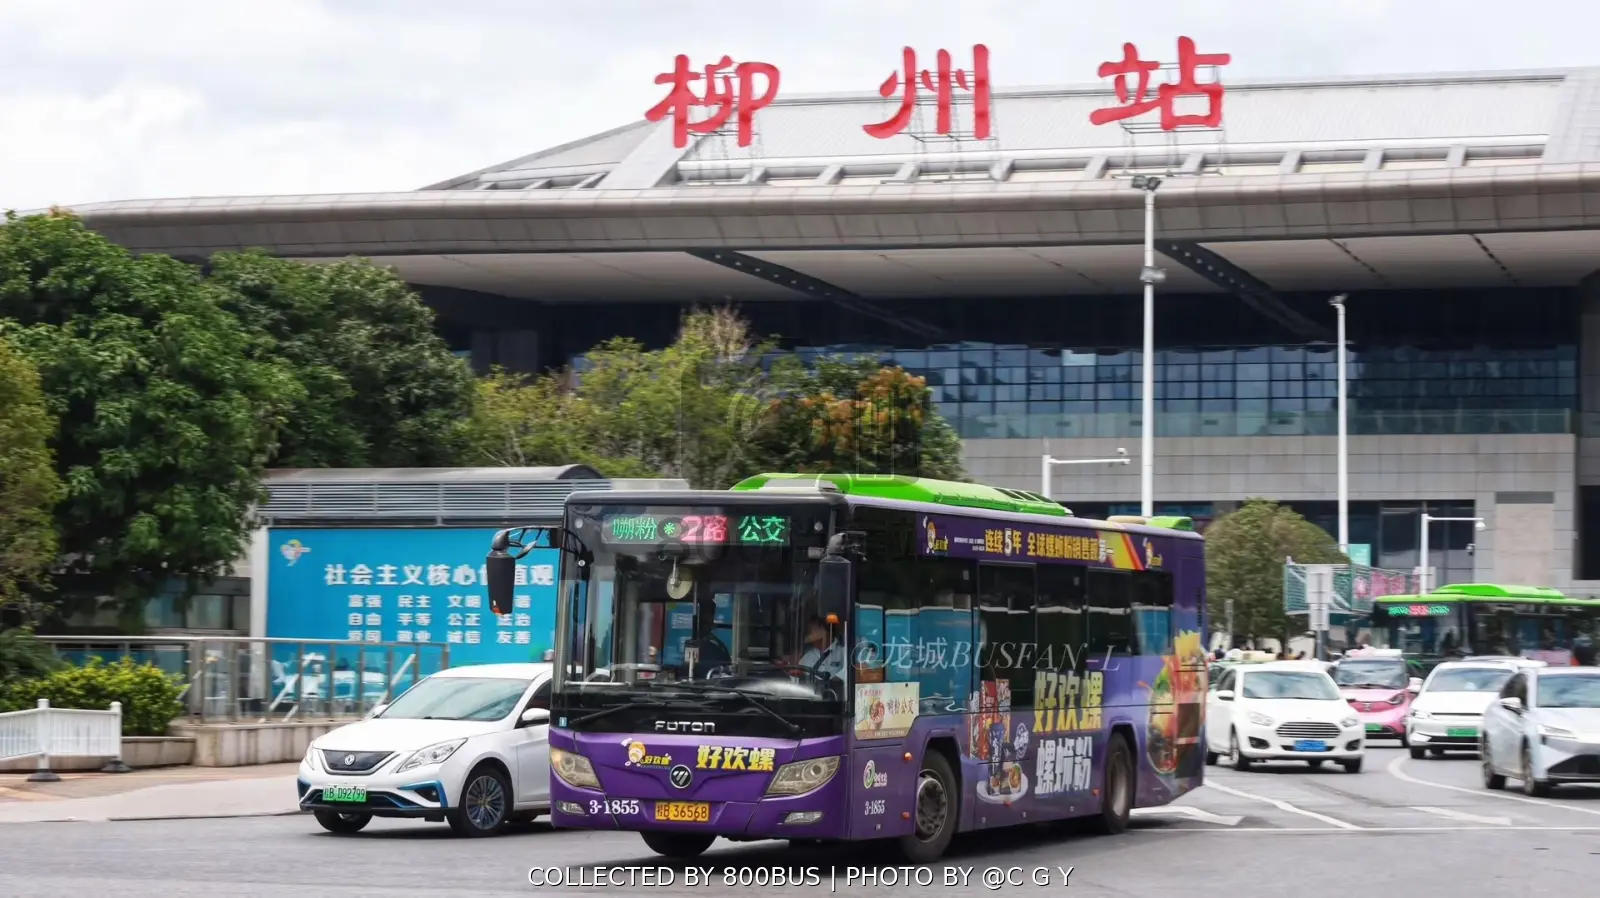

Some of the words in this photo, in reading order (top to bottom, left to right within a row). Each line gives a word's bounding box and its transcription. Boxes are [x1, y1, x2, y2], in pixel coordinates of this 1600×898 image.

[645, 36, 1231, 148] 柳州站
[681, 515, 727, 541] 2路
[738, 515, 785, 542] 公交
[324, 563, 554, 586] 社会主义核心值观
[397, 594, 431, 608] 民主
[397, 612, 431, 626] 平等
[447, 613, 481, 626] 公正
[496, 630, 531, 643] 友善
[1032, 670, 1103, 733] 好欢螺
[655, 720, 716, 733] FOTON
[696, 745, 776, 772] 好欢螺
[589, 799, 640, 815] 3-1855
[864, 800, 886, 816] 3-1855
